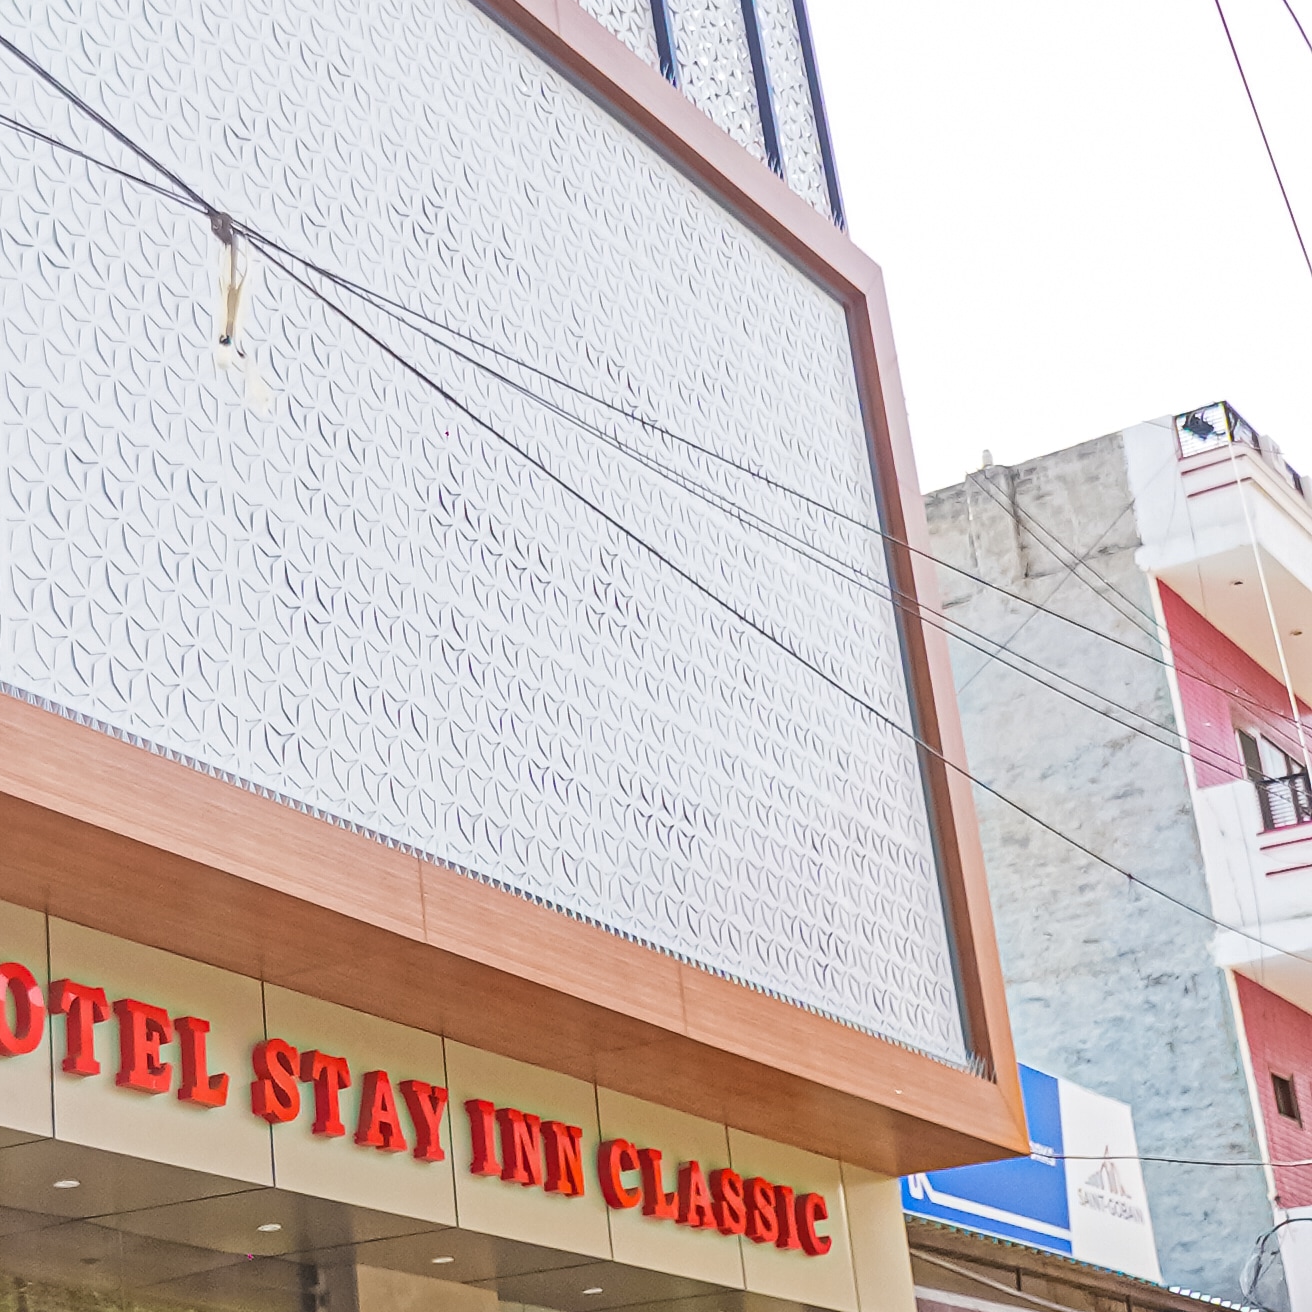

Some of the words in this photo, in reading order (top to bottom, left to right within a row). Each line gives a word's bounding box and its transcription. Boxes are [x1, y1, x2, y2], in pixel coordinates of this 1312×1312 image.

[251, 1038, 448, 1162] STAY
[464, 1098, 585, 1198] INN
[598, 1138, 832, 1257] CLASSIC
